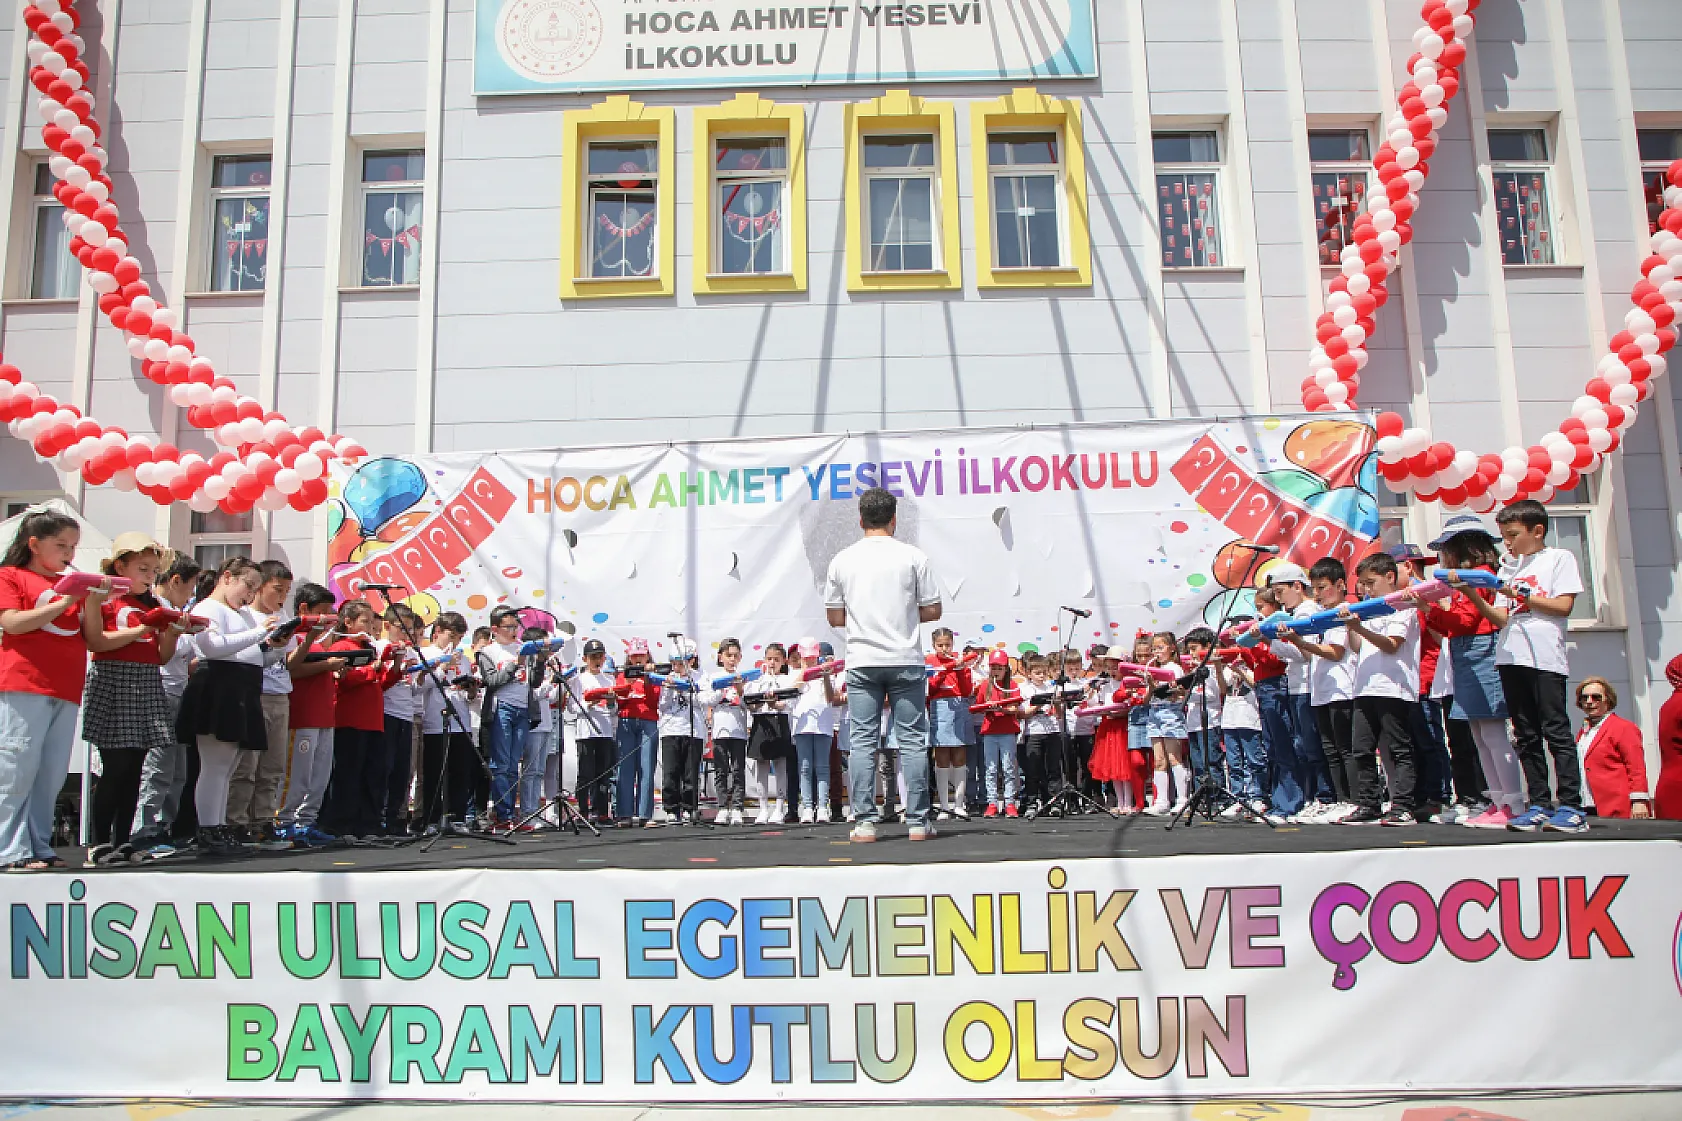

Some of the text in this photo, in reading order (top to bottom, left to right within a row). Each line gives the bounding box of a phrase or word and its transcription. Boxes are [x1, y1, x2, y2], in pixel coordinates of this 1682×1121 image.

[625, 0, 982, 34] HOCA AHMET YESEVİ
[625, 43, 797, 69] İLKOKULU
[527, 448, 1159, 513] HOCA AHMET YESEVİ İLKOKULU
[10, 866, 1635, 991] NİSAN ULUSAL EGEMENLİK VE ÇOCUK
[227, 994, 1250, 1084] BAYRAMI KUTLU OLSUN
